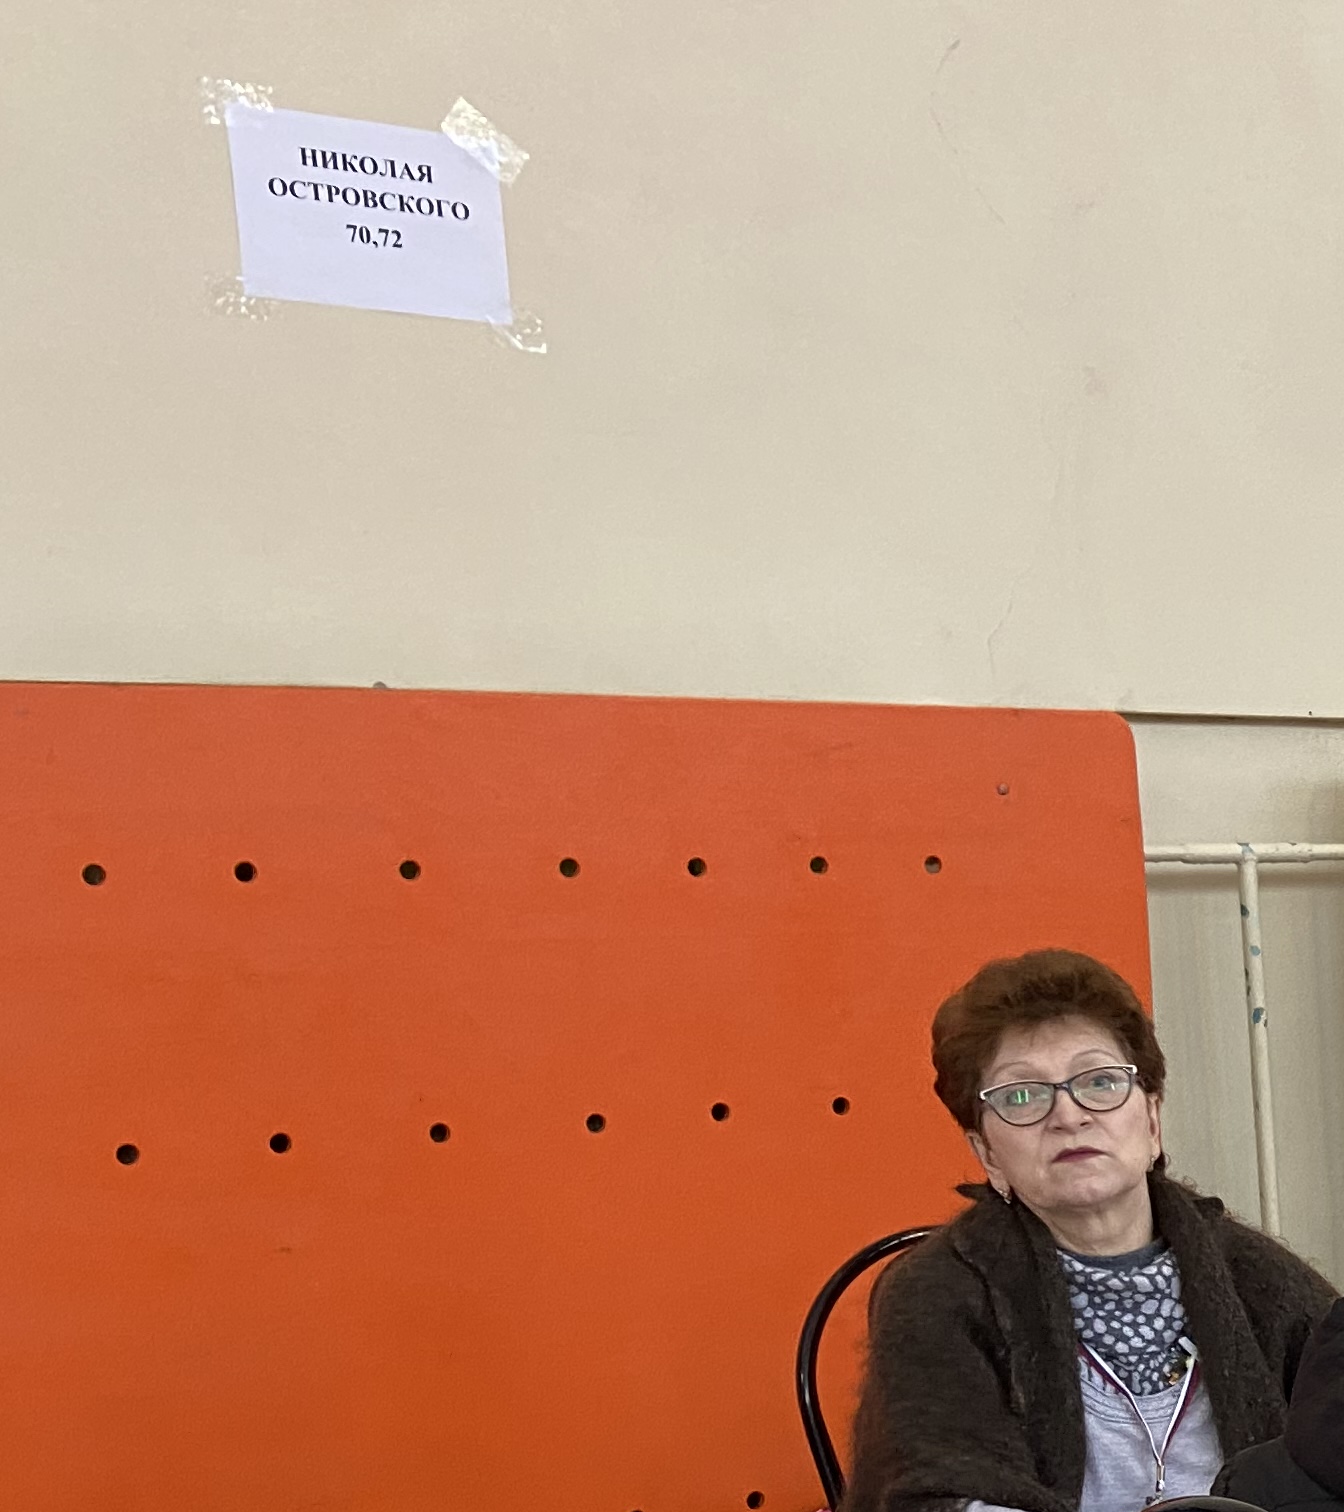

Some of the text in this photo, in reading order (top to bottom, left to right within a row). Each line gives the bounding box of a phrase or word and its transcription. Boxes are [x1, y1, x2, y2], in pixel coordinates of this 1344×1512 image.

[299, 146, 433, 184] НИКОЛАЯ
[268, 176, 470, 221] ОСТРОВСКОГО
[346, 224, 403, 249] 70,72
